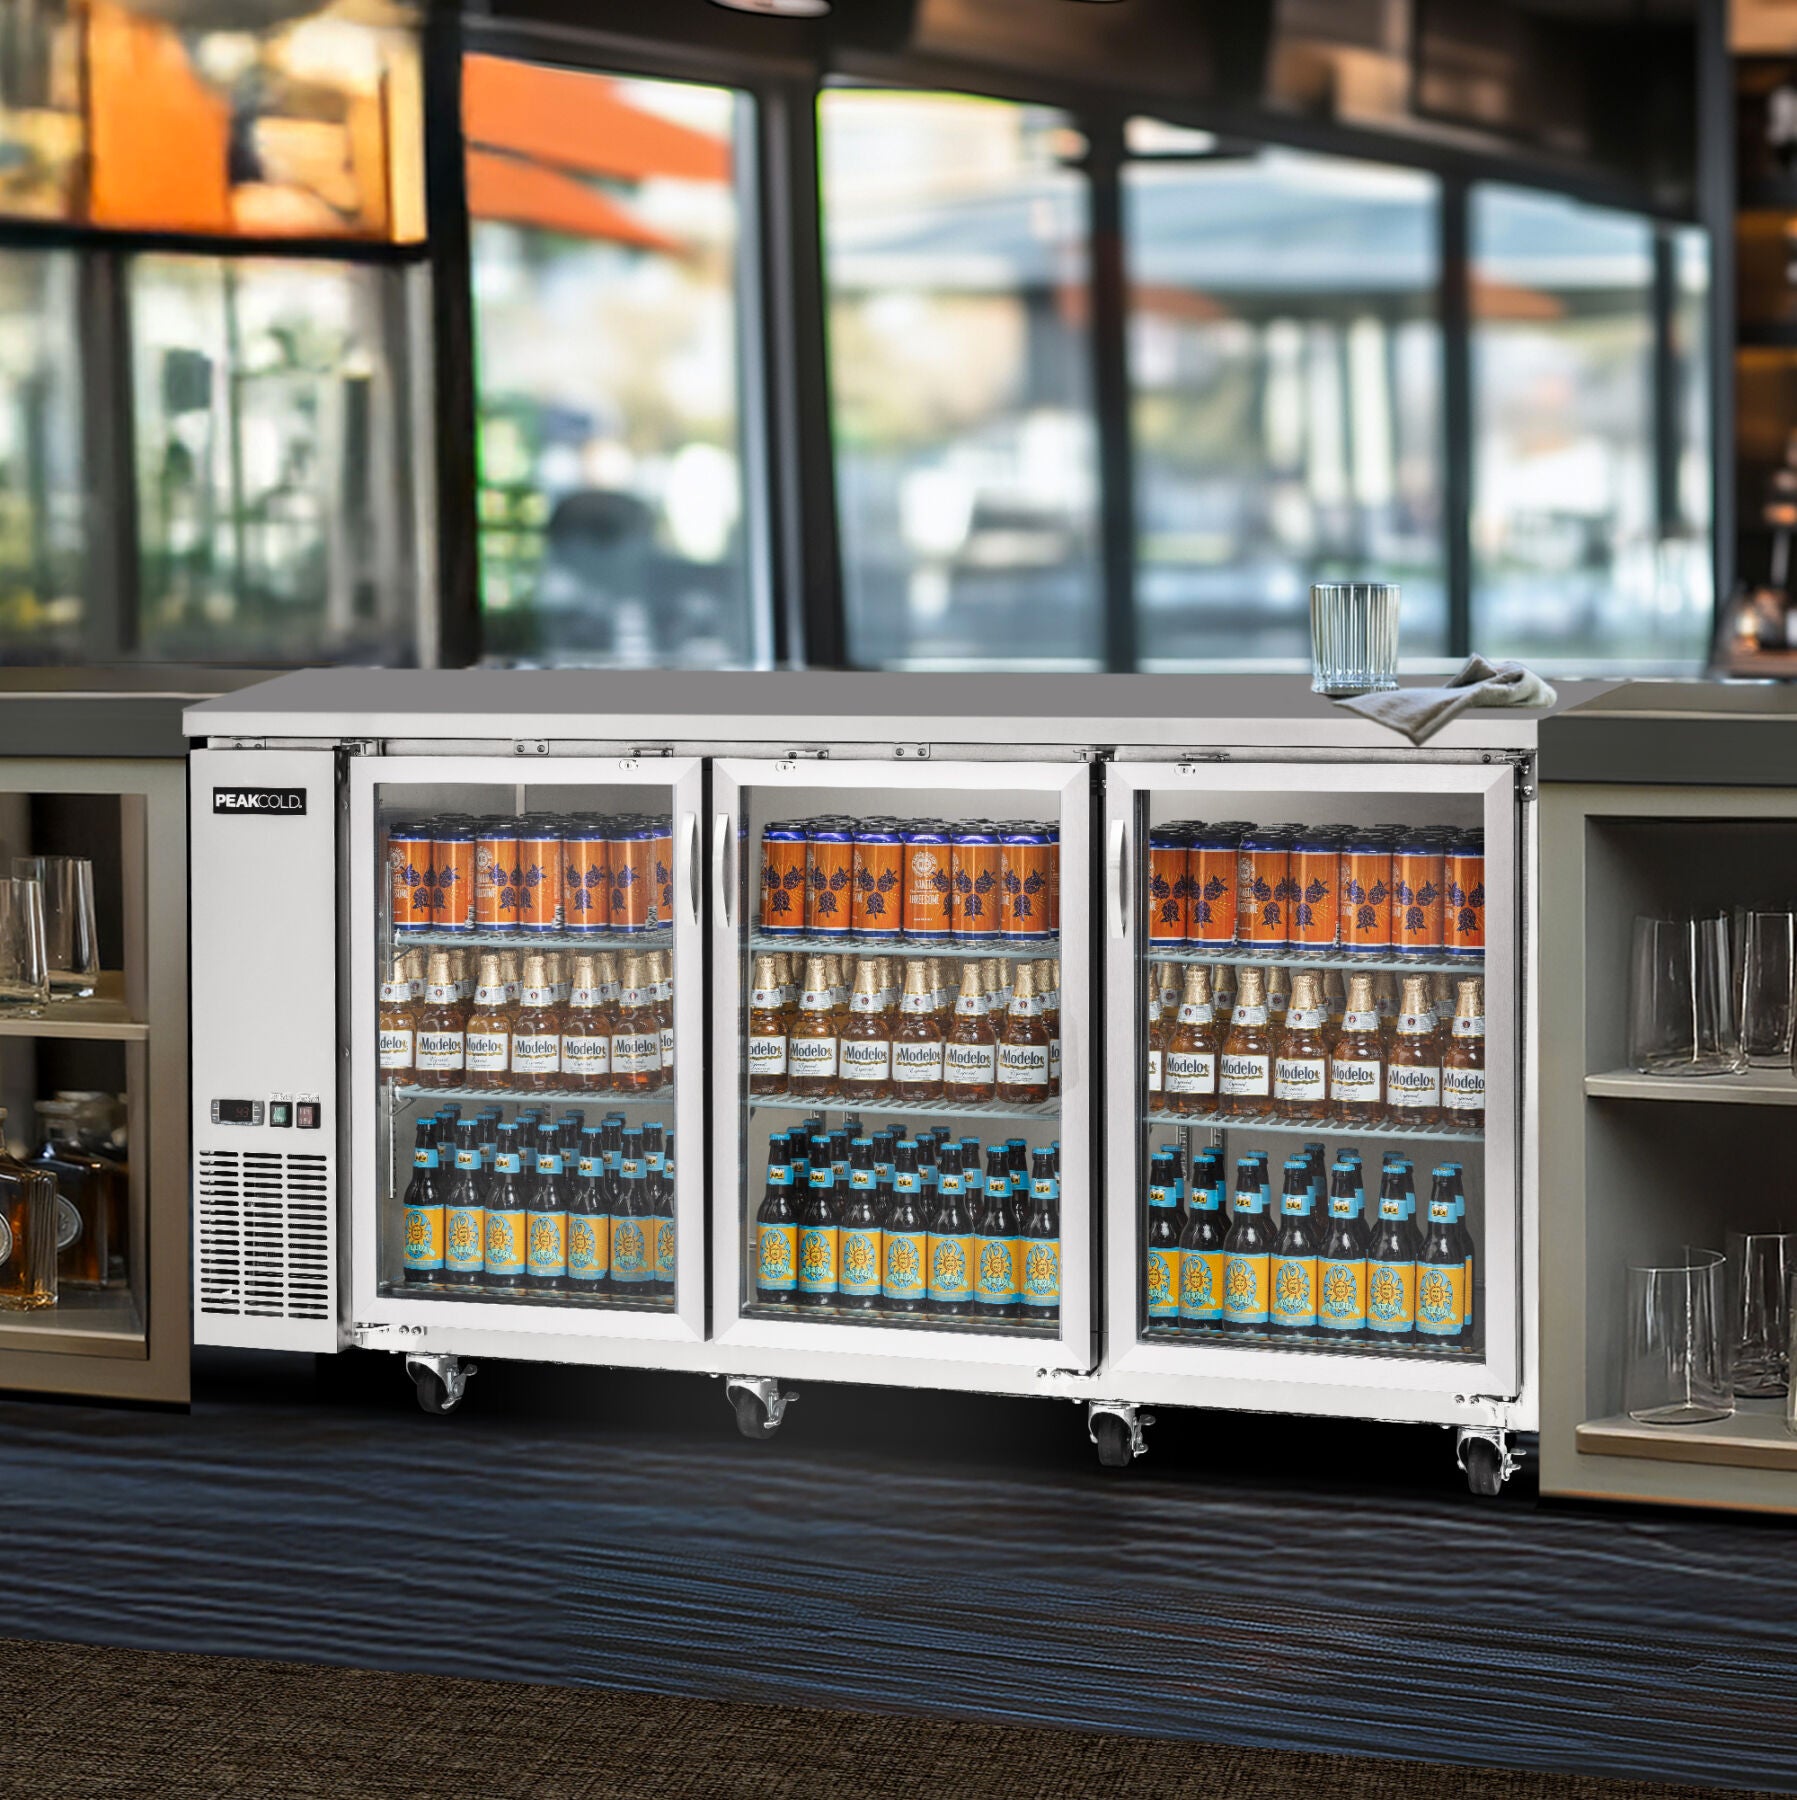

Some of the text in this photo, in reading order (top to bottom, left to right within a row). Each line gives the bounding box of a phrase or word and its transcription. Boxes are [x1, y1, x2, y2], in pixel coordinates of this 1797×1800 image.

[216, 794, 300, 808] PEAKCOLD
[380, 1036, 401, 1050] delo
[422, 1037, 457, 1051] Modelo
[517, 1040, 553, 1054] Modelo
[567, 1041, 601, 1055] Modelo
[617, 1039, 652, 1054] Modelo
[750, 1042, 776, 1055] odelo
[792, 1043, 827, 1057] Modelo
[847, 1045, 883, 1060] Modelo
[900, 1048, 937, 1062] Modelo
[950, 1049, 986, 1064] Modelo
[1004, 1050, 1039, 1065] Modelo
[1167, 1057, 1203, 1073] Modelo
[1222, 1059, 1258, 1075] Modelo
[1278, 1064, 1314, 1080] Modelo
[1333, 1064, 1368, 1080] Modelo
[1392, 1070, 1429, 1086] Modelo
[1446, 1073, 1484, 1089] Modelo
